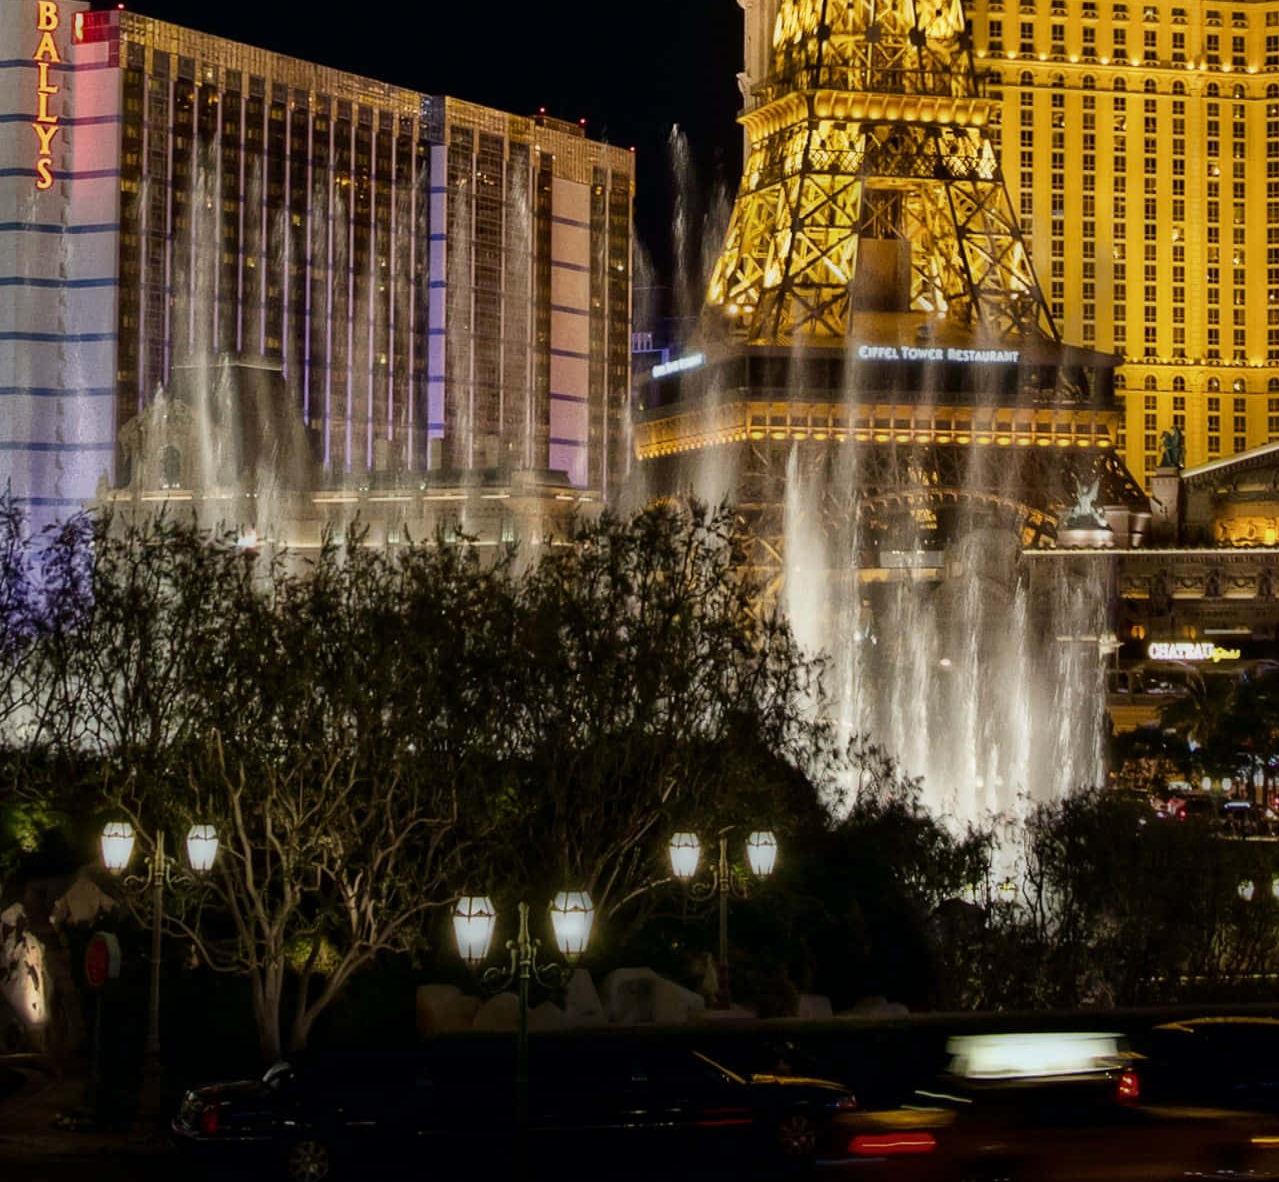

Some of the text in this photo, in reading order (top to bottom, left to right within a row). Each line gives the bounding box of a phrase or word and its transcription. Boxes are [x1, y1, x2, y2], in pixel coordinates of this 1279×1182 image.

[858, 345, 1019, 363] EIFFEL TOWER RESTAURANT
